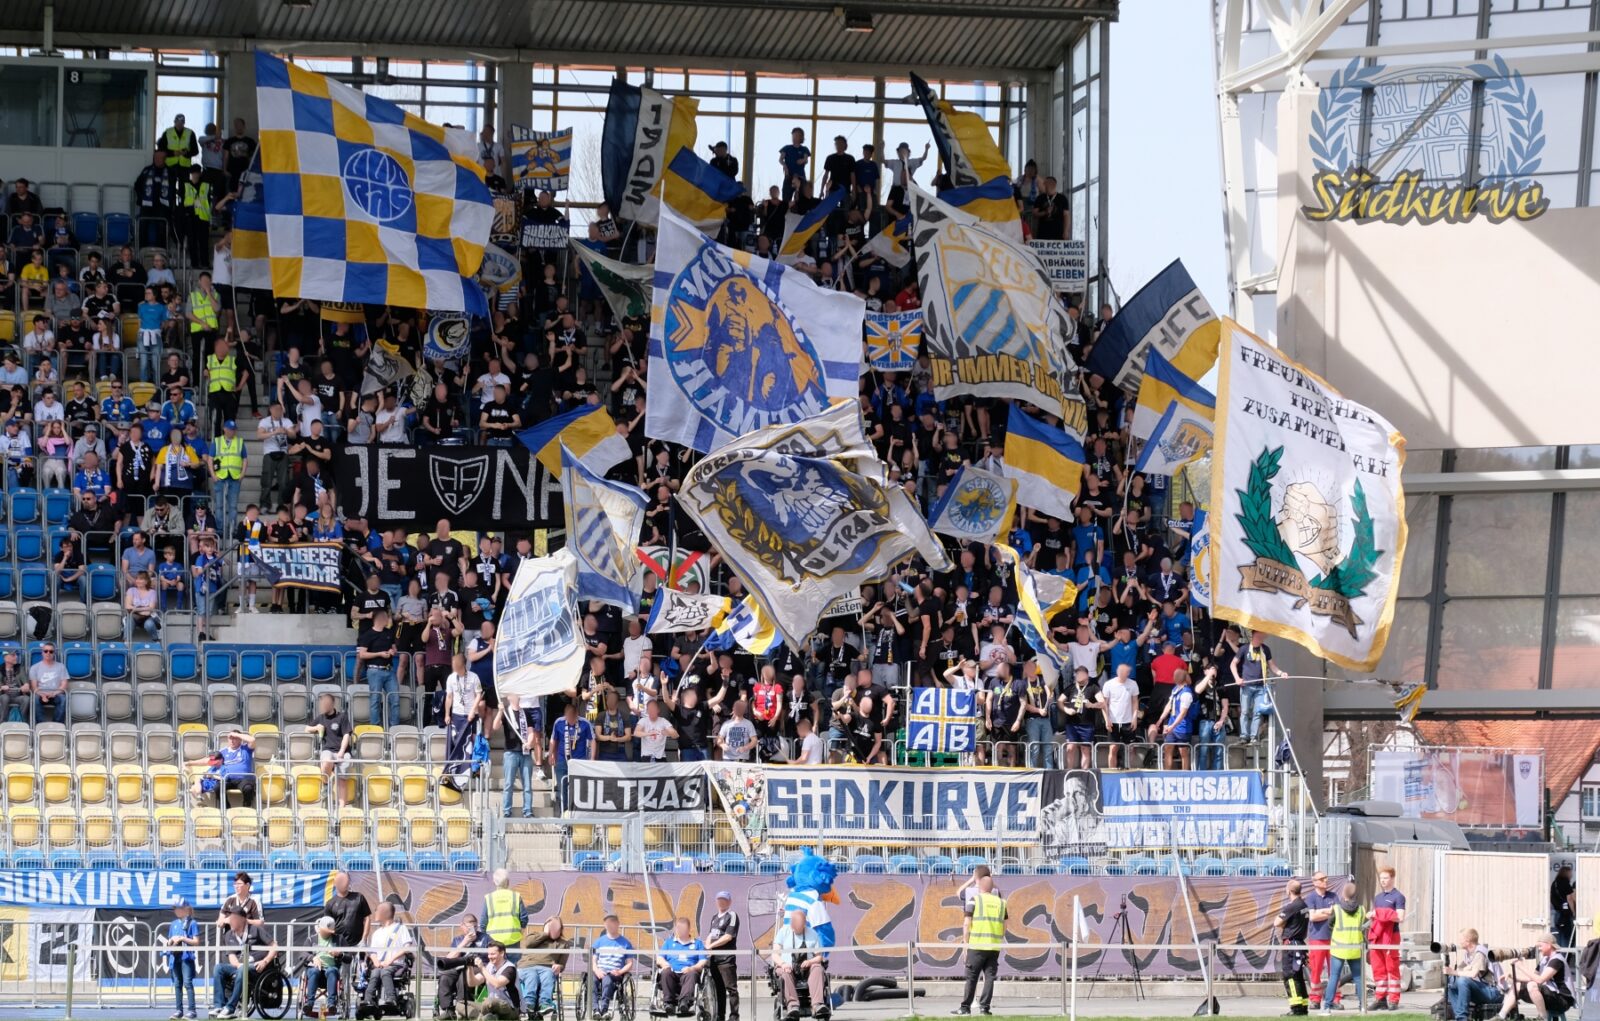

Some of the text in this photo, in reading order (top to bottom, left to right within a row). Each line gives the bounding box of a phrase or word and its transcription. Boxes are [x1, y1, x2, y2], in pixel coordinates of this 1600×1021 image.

[71, 71, 79, 83] 8
[1046, 242, 1062, 250] FCC
[1063, 241, 1085, 249] MUSS
[1050, 269, 1085, 279] LEIBEN
[958, 352, 1031, 386] IMMER
[829, 602, 862, 615] nisten
[573, 778, 701, 811] ULTRAS
[1120, 776, 1248, 801] UNBEUGSAM
[767, 777, 1038, 831] SÜDKURVE
[1173, 805, 1191, 814] UND
